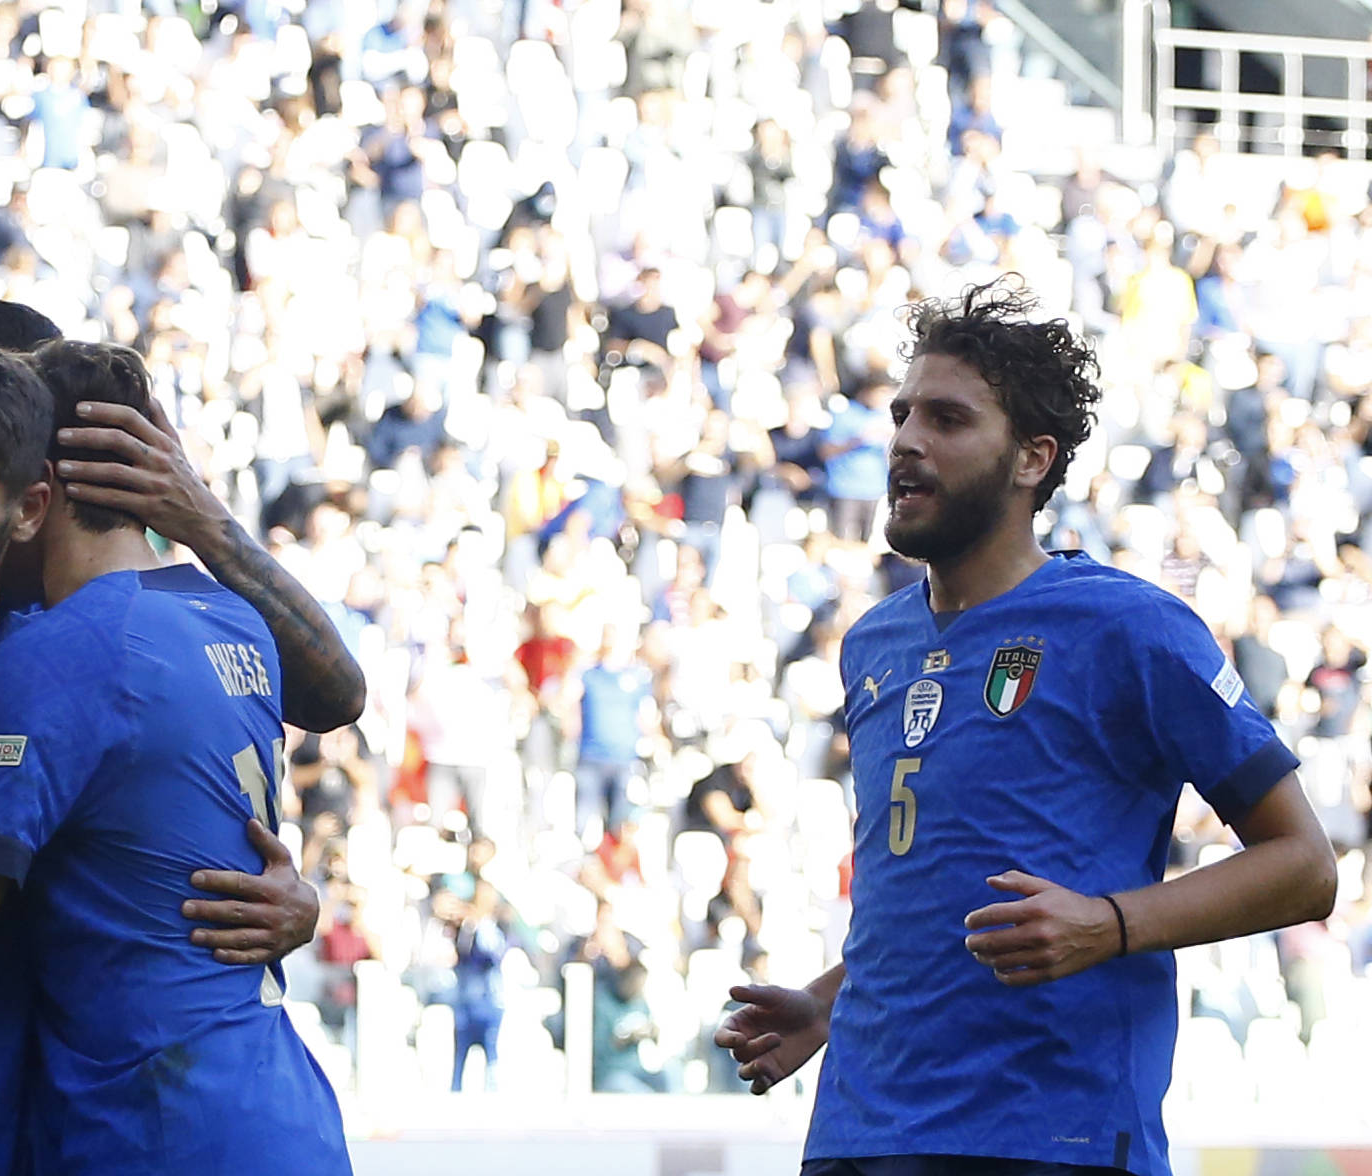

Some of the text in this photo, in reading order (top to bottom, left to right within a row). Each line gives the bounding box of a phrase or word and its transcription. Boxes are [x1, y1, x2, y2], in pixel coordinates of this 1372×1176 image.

[204, 643, 272, 696] CHIESA
[998, 651, 1038, 664] ITALIA
[889, 758, 921, 856] 5
